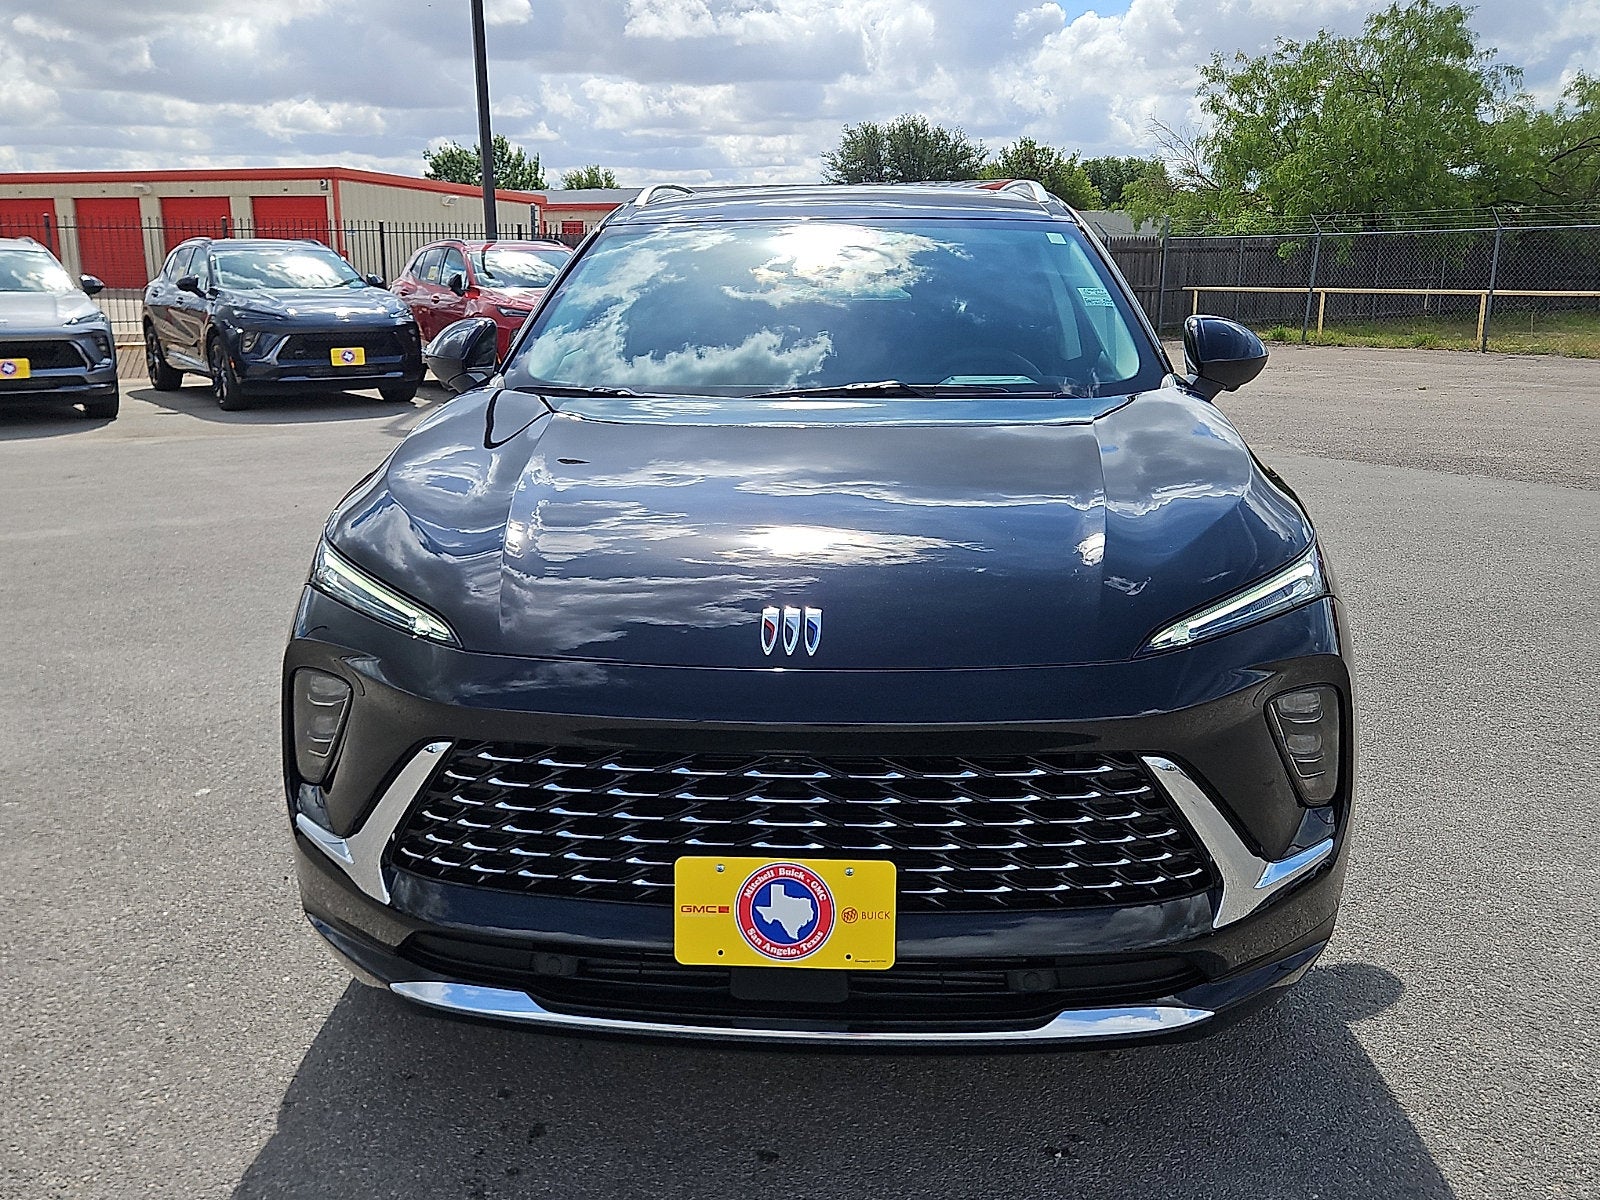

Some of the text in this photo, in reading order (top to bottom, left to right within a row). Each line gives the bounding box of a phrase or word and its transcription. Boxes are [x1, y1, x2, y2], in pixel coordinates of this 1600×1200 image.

[744, 868, 827, 901] Mitchell Buick GMC
[681, 905, 717, 914] GMC
[861, 911, 891, 920] BUICK
[747, 927, 824, 956] San Angelo, Texas
